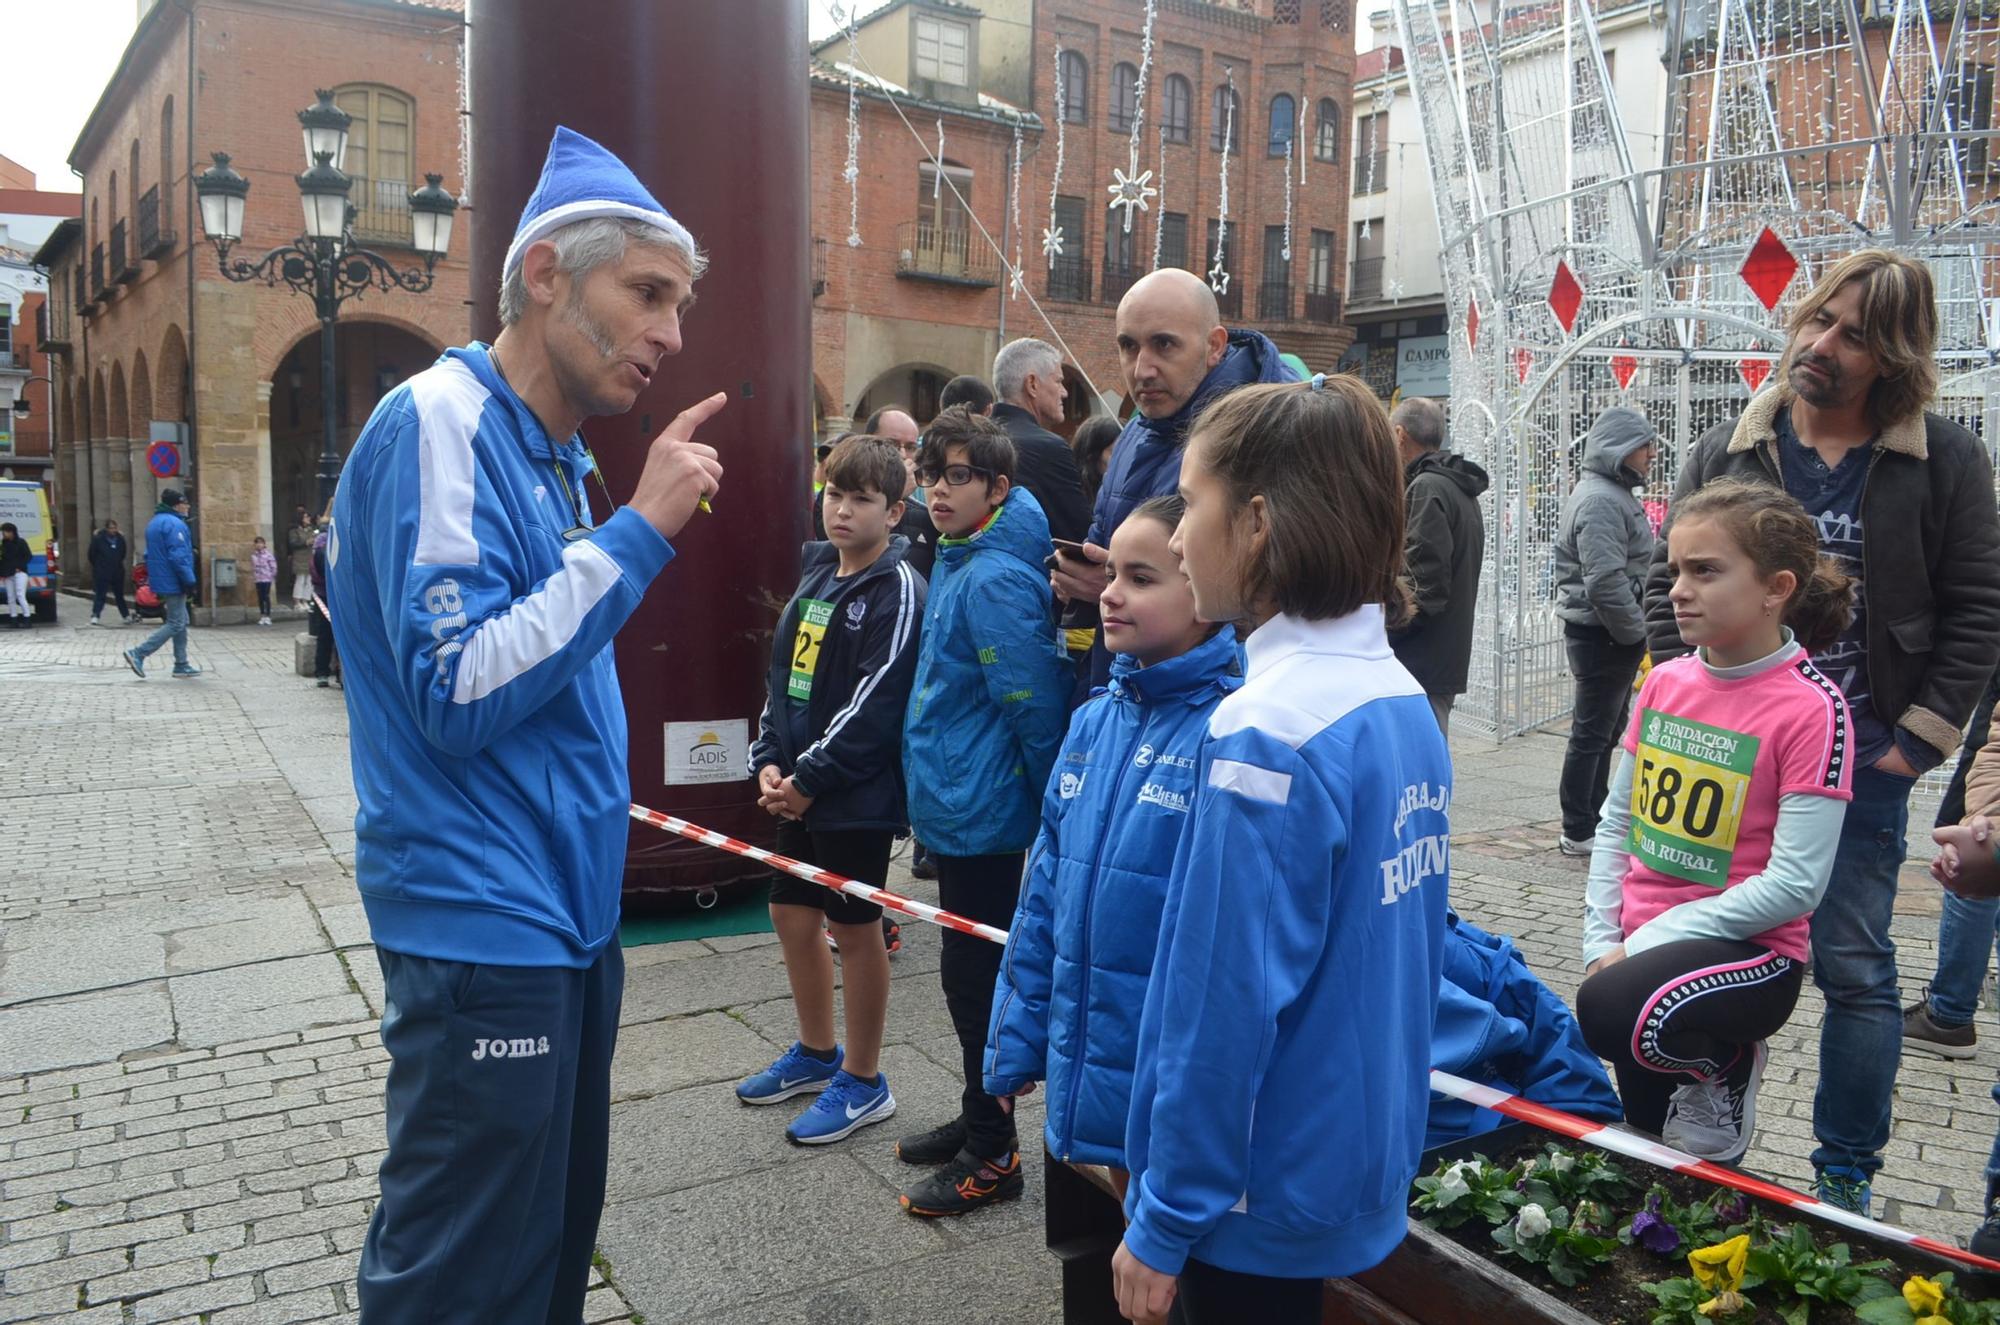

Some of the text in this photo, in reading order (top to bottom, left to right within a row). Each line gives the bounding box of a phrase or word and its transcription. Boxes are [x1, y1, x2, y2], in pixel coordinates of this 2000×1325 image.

[689, 750, 728, 765] LADIS
[1660, 734, 1682, 752] CAJA
[1685, 742, 1732, 766] RURAL
[1639, 759, 1725, 839] 580
[1657, 844, 1718, 874] RURAL
